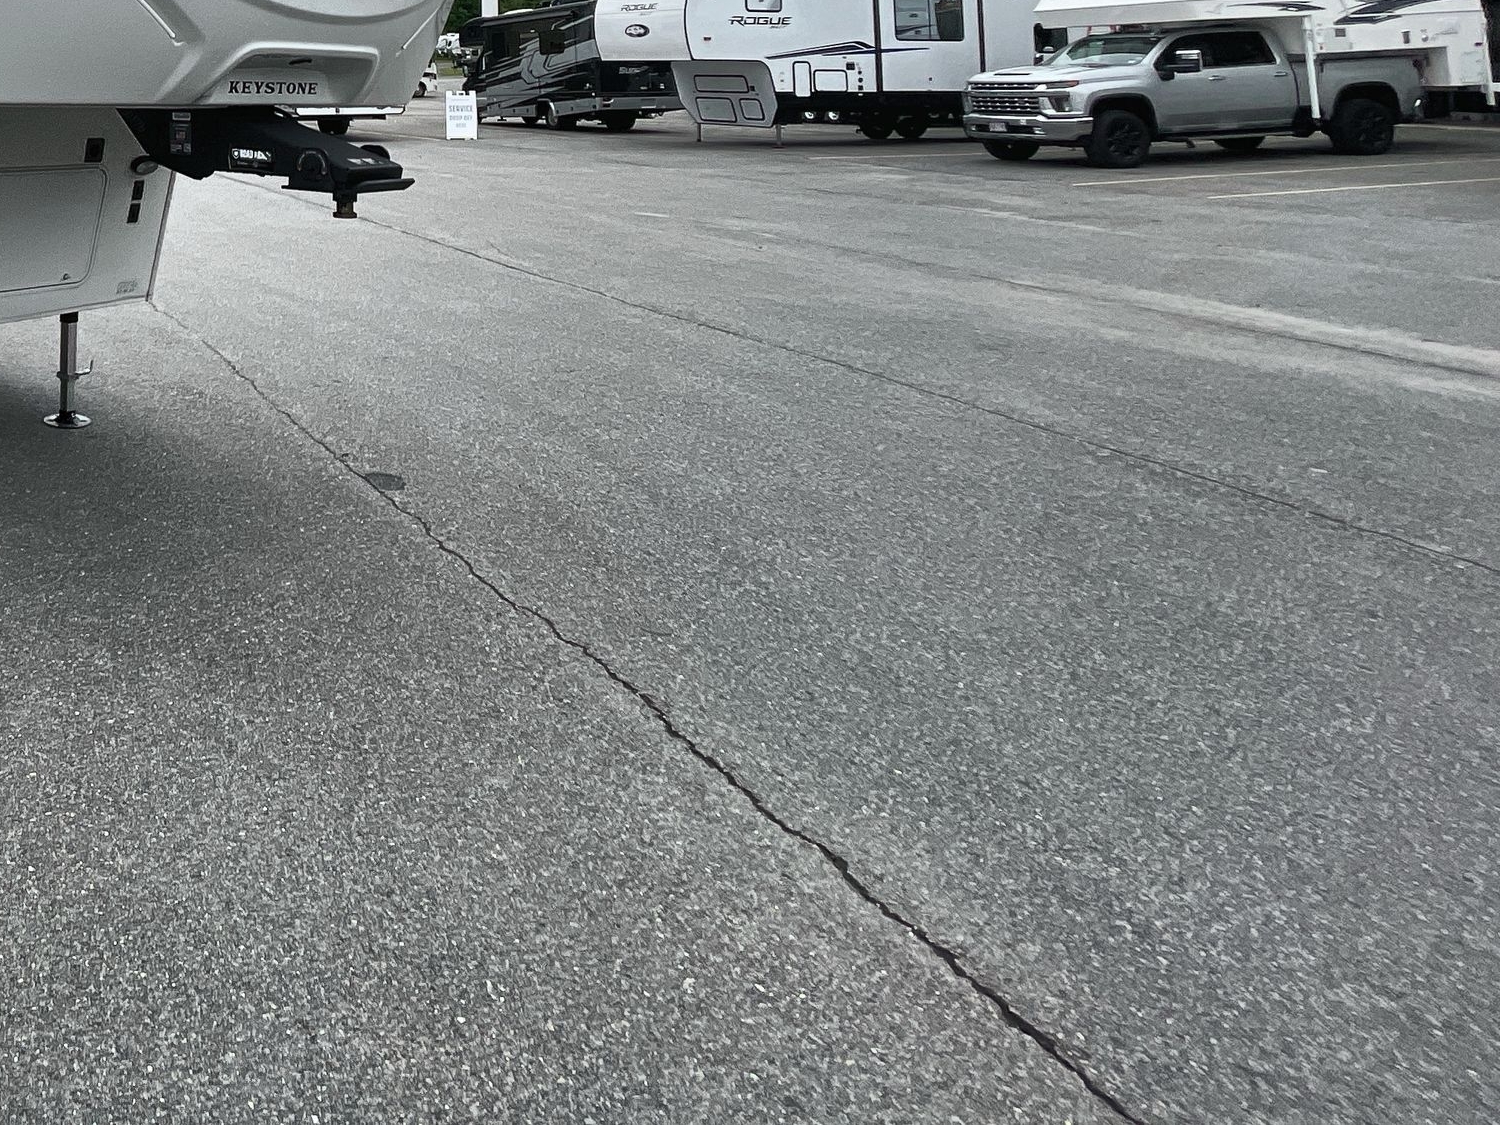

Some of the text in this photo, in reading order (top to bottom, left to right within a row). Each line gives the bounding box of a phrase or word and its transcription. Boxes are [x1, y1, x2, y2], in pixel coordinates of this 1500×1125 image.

[620, 2, 659, 12] ROGUE
[728, 15, 793, 27] ROGUE
[227, 80, 319, 95] KEYSTONE
